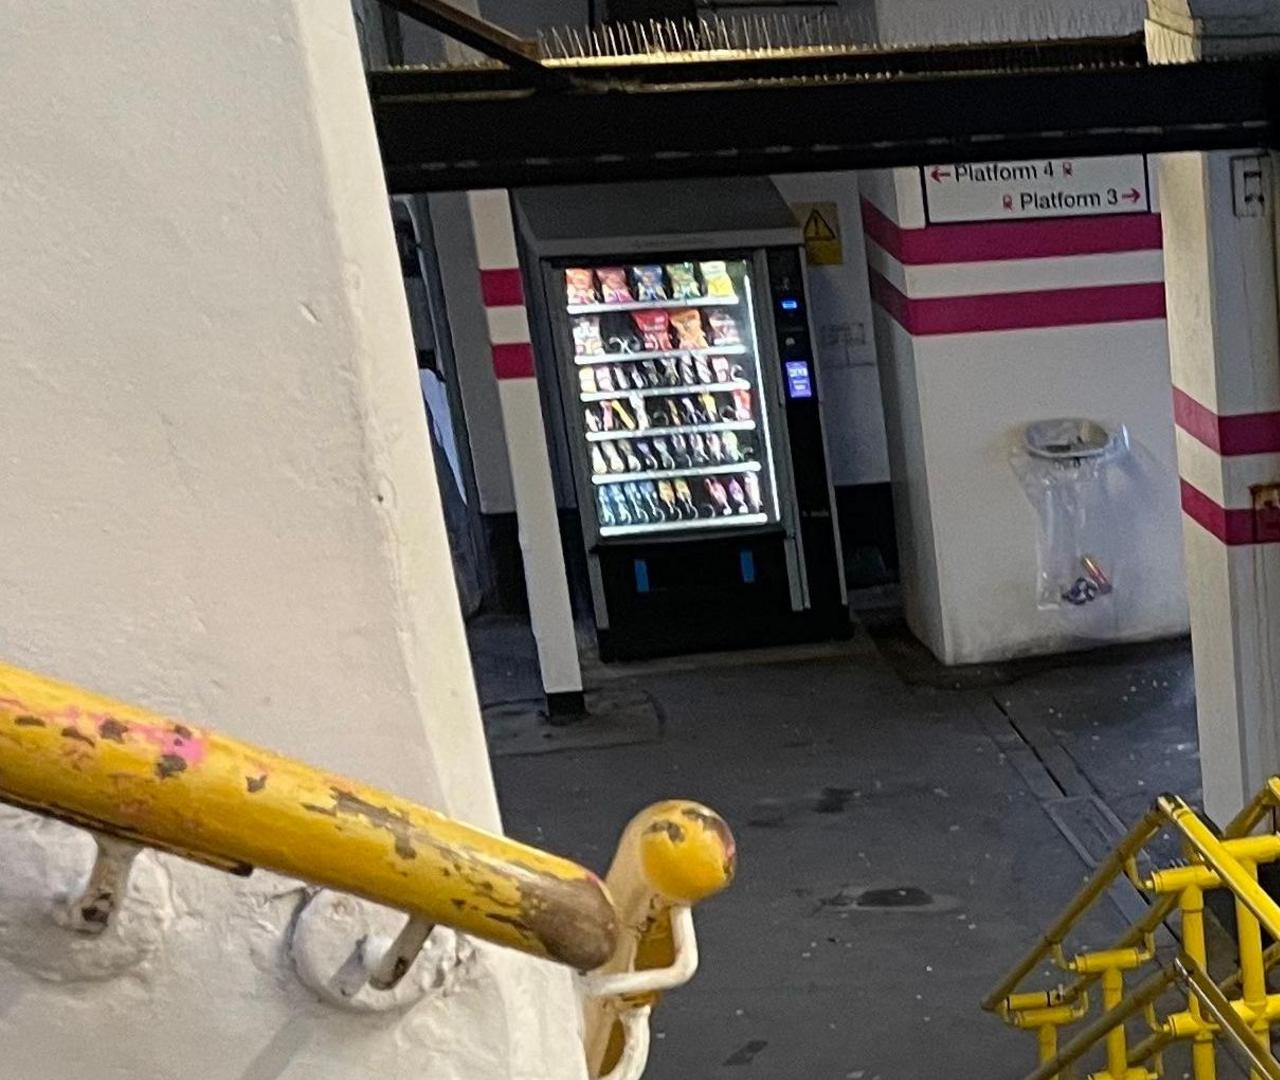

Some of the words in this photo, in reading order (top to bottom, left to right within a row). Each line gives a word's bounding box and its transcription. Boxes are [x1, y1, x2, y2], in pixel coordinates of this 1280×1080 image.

[954, 162, 1037, 182] Platform
[1043, 161, 1054, 177] 4
[1020, 190, 1101, 211] Platform
[1106, 188, 1118, 206] 3
